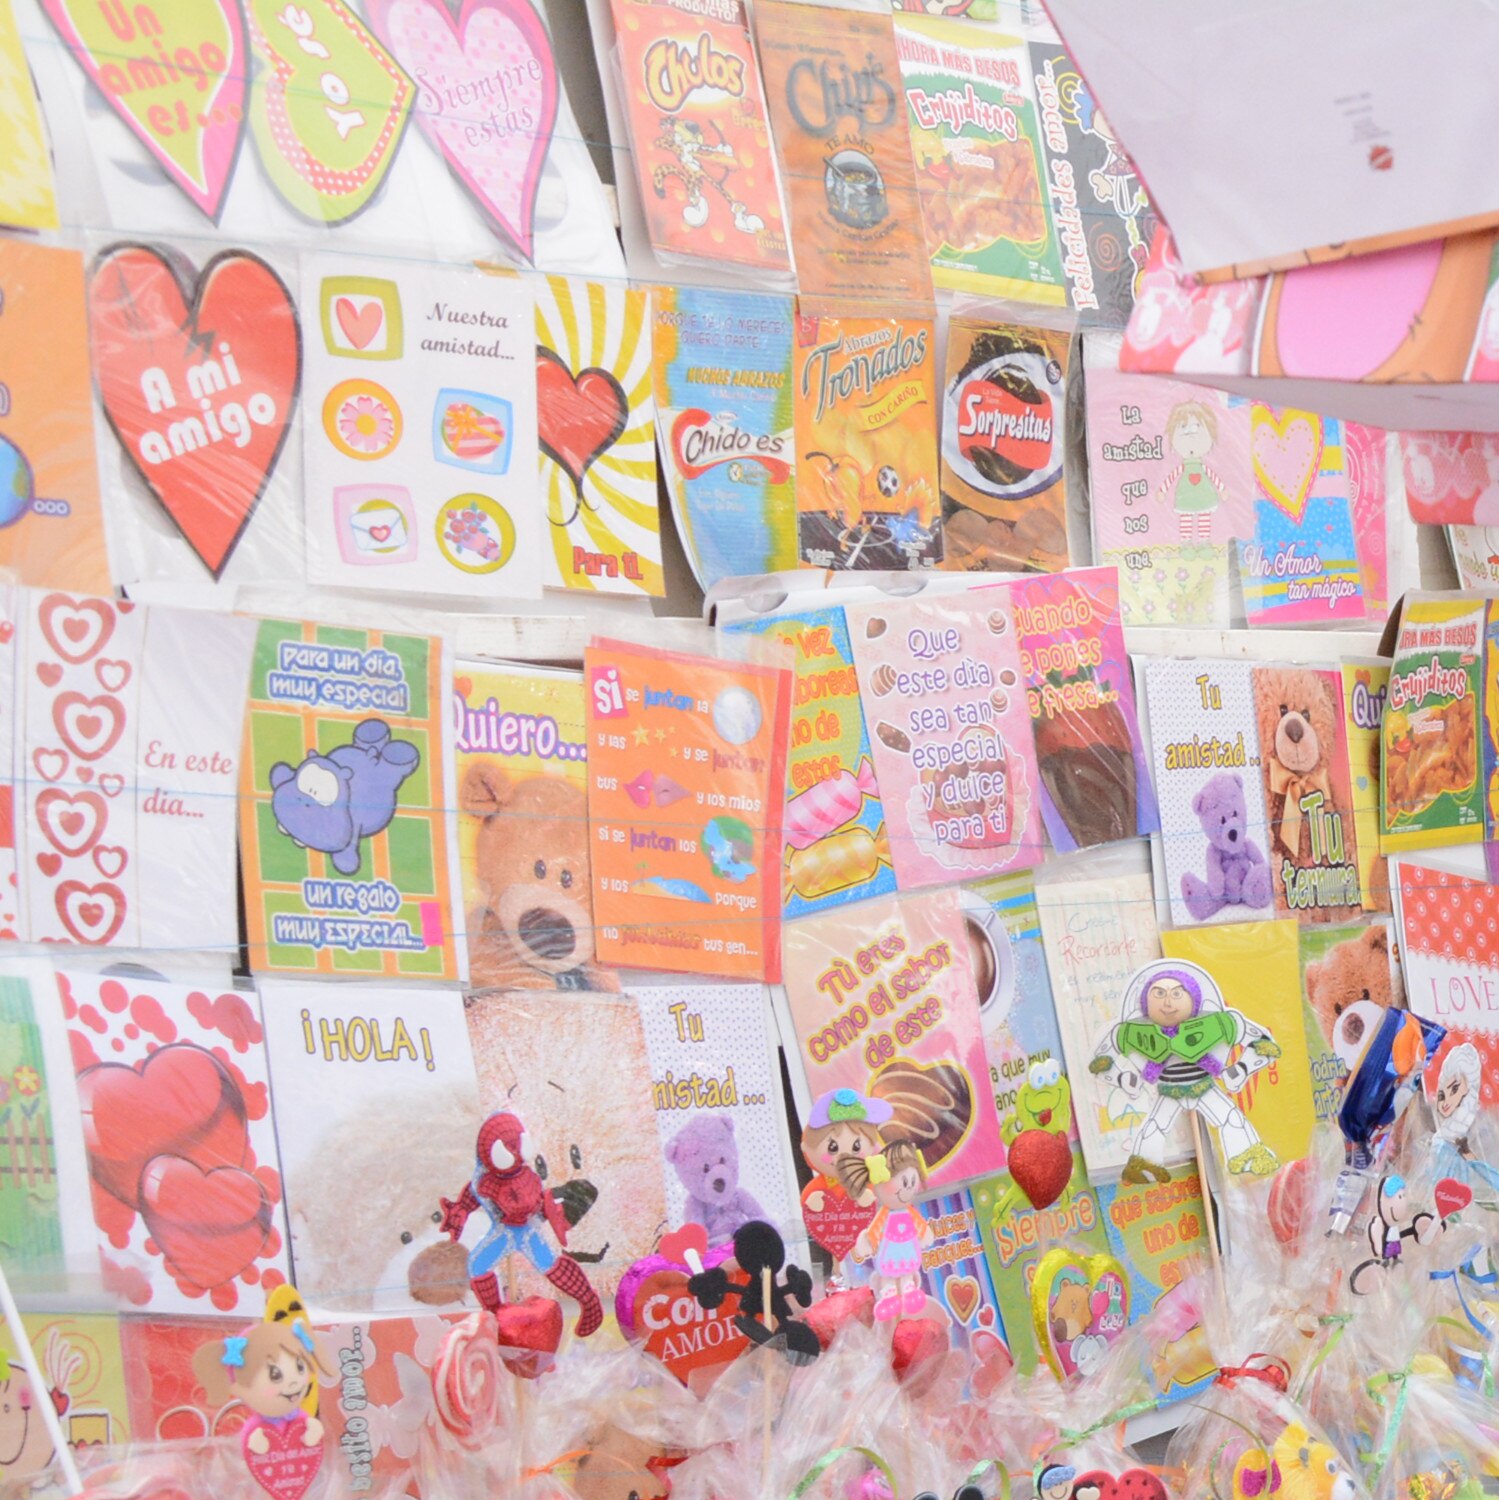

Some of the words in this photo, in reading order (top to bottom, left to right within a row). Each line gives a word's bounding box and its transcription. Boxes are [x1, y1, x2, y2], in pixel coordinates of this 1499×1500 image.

[99, 41, 228, 95] amigo
[645, 31, 745, 114] Chulos
[975, 57, 1022, 88] BESOS
[416, 57, 543, 115] Siempre
[906, 83, 1018, 142] Crujiditos
[844, 132, 875, 155] AMO
[1049, 158, 1101, 311] Felicidades
[425, 302, 509, 331] Nuestra
[420, 334, 515, 363] amistad...
[845, 330, 893, 356] Abrazos
[139, 366, 176, 414] A
[186, 343, 241, 395] mi
[802, 325, 928, 422] Tronados
[138, 394, 277, 464] amigo
[867, 406, 884, 425] CON
[959, 394, 1052, 449] Sorpresitas
[1120, 404, 1142, 426] La
[685, 427, 750, 465] Chido
[756, 434, 785, 453] es
[1102, 434, 1164, 462] amistad
[1121, 478, 1149, 508] que
[1123, 513, 1150, 534] nos
[571, 545, 620, 579] Para
[1273, 543, 1322, 579] Amor
[1287, 579, 1311, 601] tan
[800, 626, 836, 659] vez
[907, 627, 960, 659] Que
[1444, 622, 1477, 649] BESOS
[282, 645, 330, 670] para
[334, 648, 362, 674] un
[1037, 638, 1102, 677] pones
[271, 675, 318, 702] muy
[321, 681, 406, 709] especial
[593, 668, 625, 715] Si
[626, 688, 640, 702] se
[643, 685, 694, 711] juntan
[697, 699, 709, 714] la
[897, 665, 946, 694] este
[1195, 674, 1223, 710] Tu
[1389, 656, 1466, 711] Crujiditos
[815, 709, 840, 742] de
[909, 705, 949, 734] sea
[953, 699, 992, 727] tan
[143, 739, 177, 771] En
[184, 748, 233, 776] este
[608, 734, 627, 750] las
[694, 746, 709, 762] se
[911, 734, 1005, 770] especial
[1164, 733, 1248, 770] amistad
[596, 775, 618, 791] tus
[792, 754, 841, 790] estos
[922, 782, 938, 806] y
[941, 770, 1005, 804] dulce
[707, 791, 726, 807] los
[612, 829, 626, 843] se
[629, 827, 677, 852] juntan
[679, 838, 697, 854] los
[933, 815, 984, 846] para
[989, 805, 1006, 832] ti
[1300, 792, 1345, 866] Tu
[305, 881, 335, 906] un
[337, 883, 399, 913] regalo
[610, 877, 629, 893] los
[715, 891, 758, 912] porque
[276, 917, 321, 945] muy
[602, 926, 619, 941] no
[703, 938, 723, 954] tus
[858, 928, 906, 971] eres
[808, 1004, 869, 1062] como
[868, 982, 894, 1017] el
[894, 939, 952, 1001] sabor
[1430, 973, 1499, 1015] LOVE
[669, 1002, 706, 1044] Tu
[865, 1030, 893, 1067] de
[894, 996, 942, 1043] este
[998, 1191, 1097, 1268] Siempre
[1111, 1197, 1144, 1227] que
[1143, 1225, 1178, 1255] uno
[1179, 1215, 1201, 1241] de
[661, 1312, 745, 1364] AMOR
